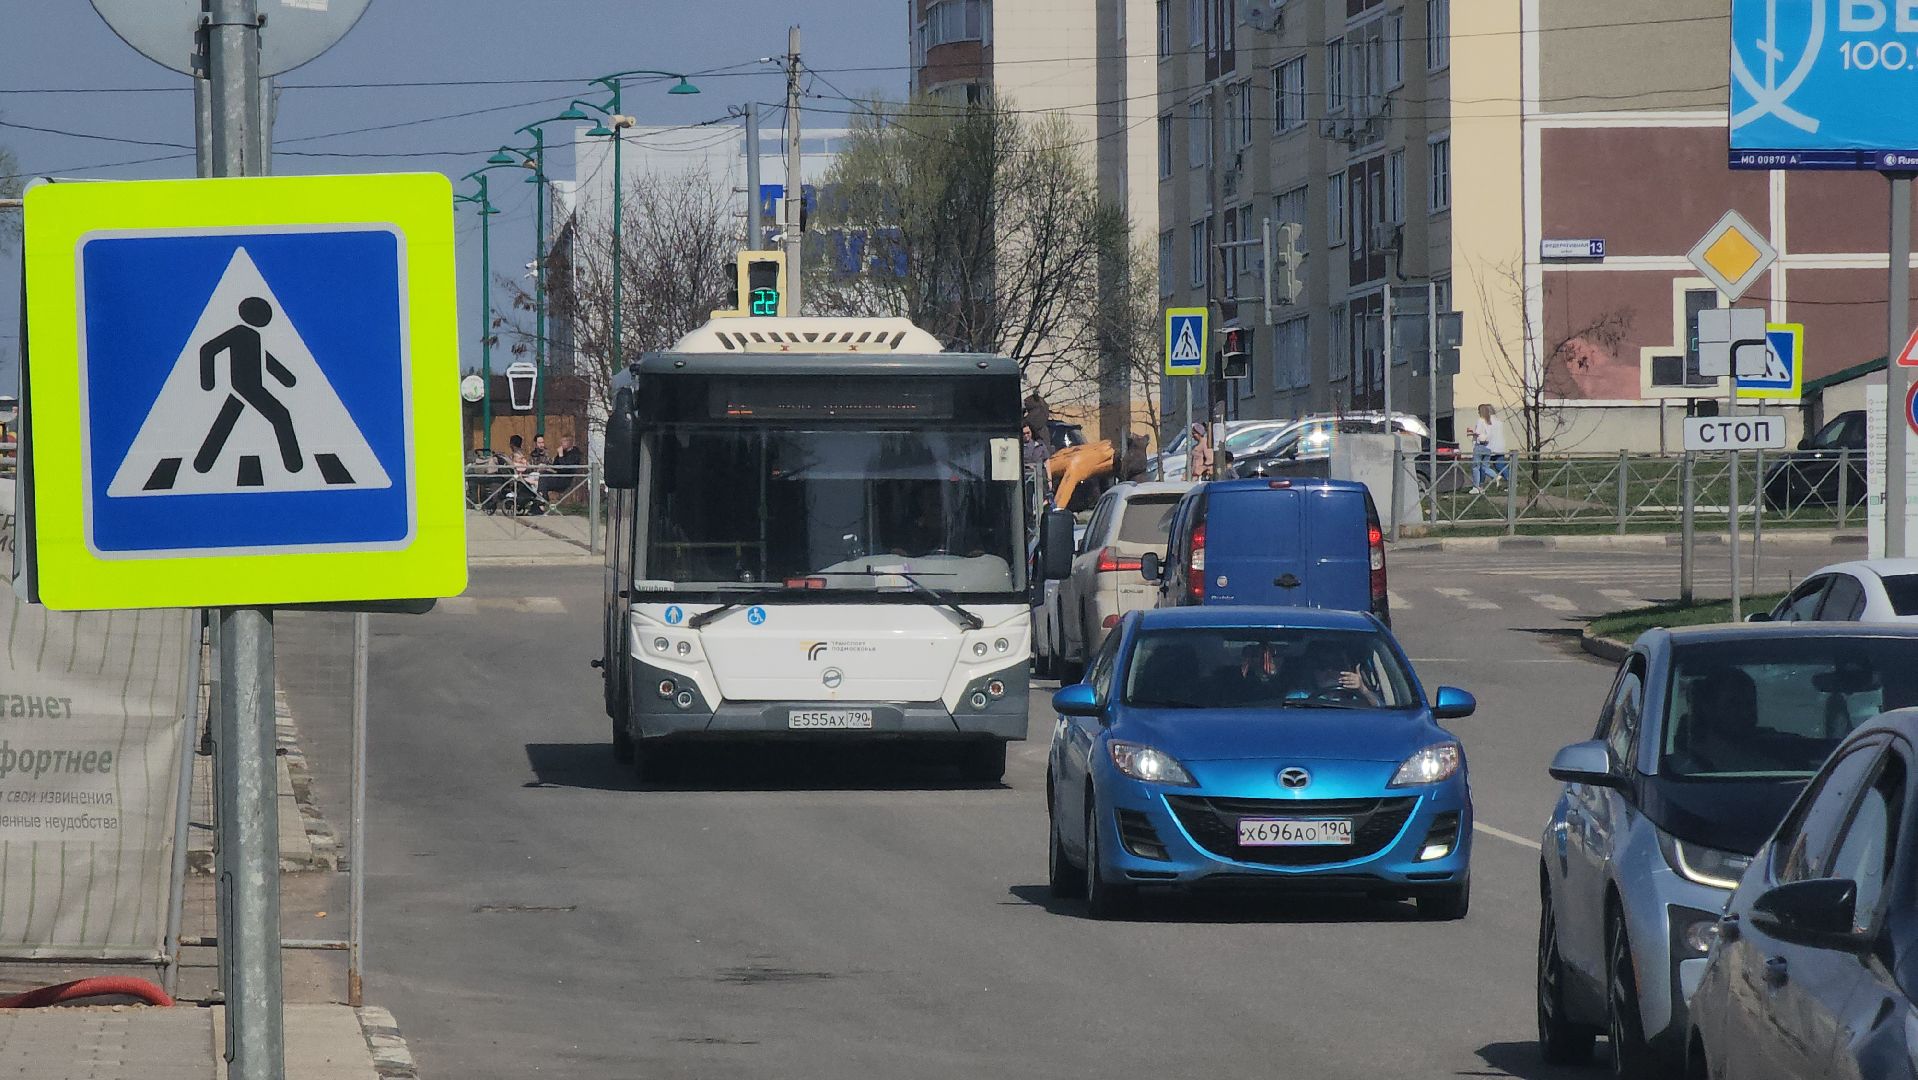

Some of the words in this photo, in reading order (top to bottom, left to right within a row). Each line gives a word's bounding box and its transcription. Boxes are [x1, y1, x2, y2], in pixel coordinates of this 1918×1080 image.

[1840, 41, 1918, 70] 100.
[1590, 242, 1603, 253] 13
[753, 291, 777, 315] 22
[1699, 421, 1770, 443] СТОП
[793, 713, 845, 726] Е555АХ
[848, 712, 868, 722] 790
[7, 791, 36, 803] свои
[40, 791, 113, 805] извинения
[0, 815, 41, 828] енные
[45, 813, 118, 832] неудобства
[1246, 823, 1317, 841] Х696АО
[1320, 822, 1346, 835] 190
